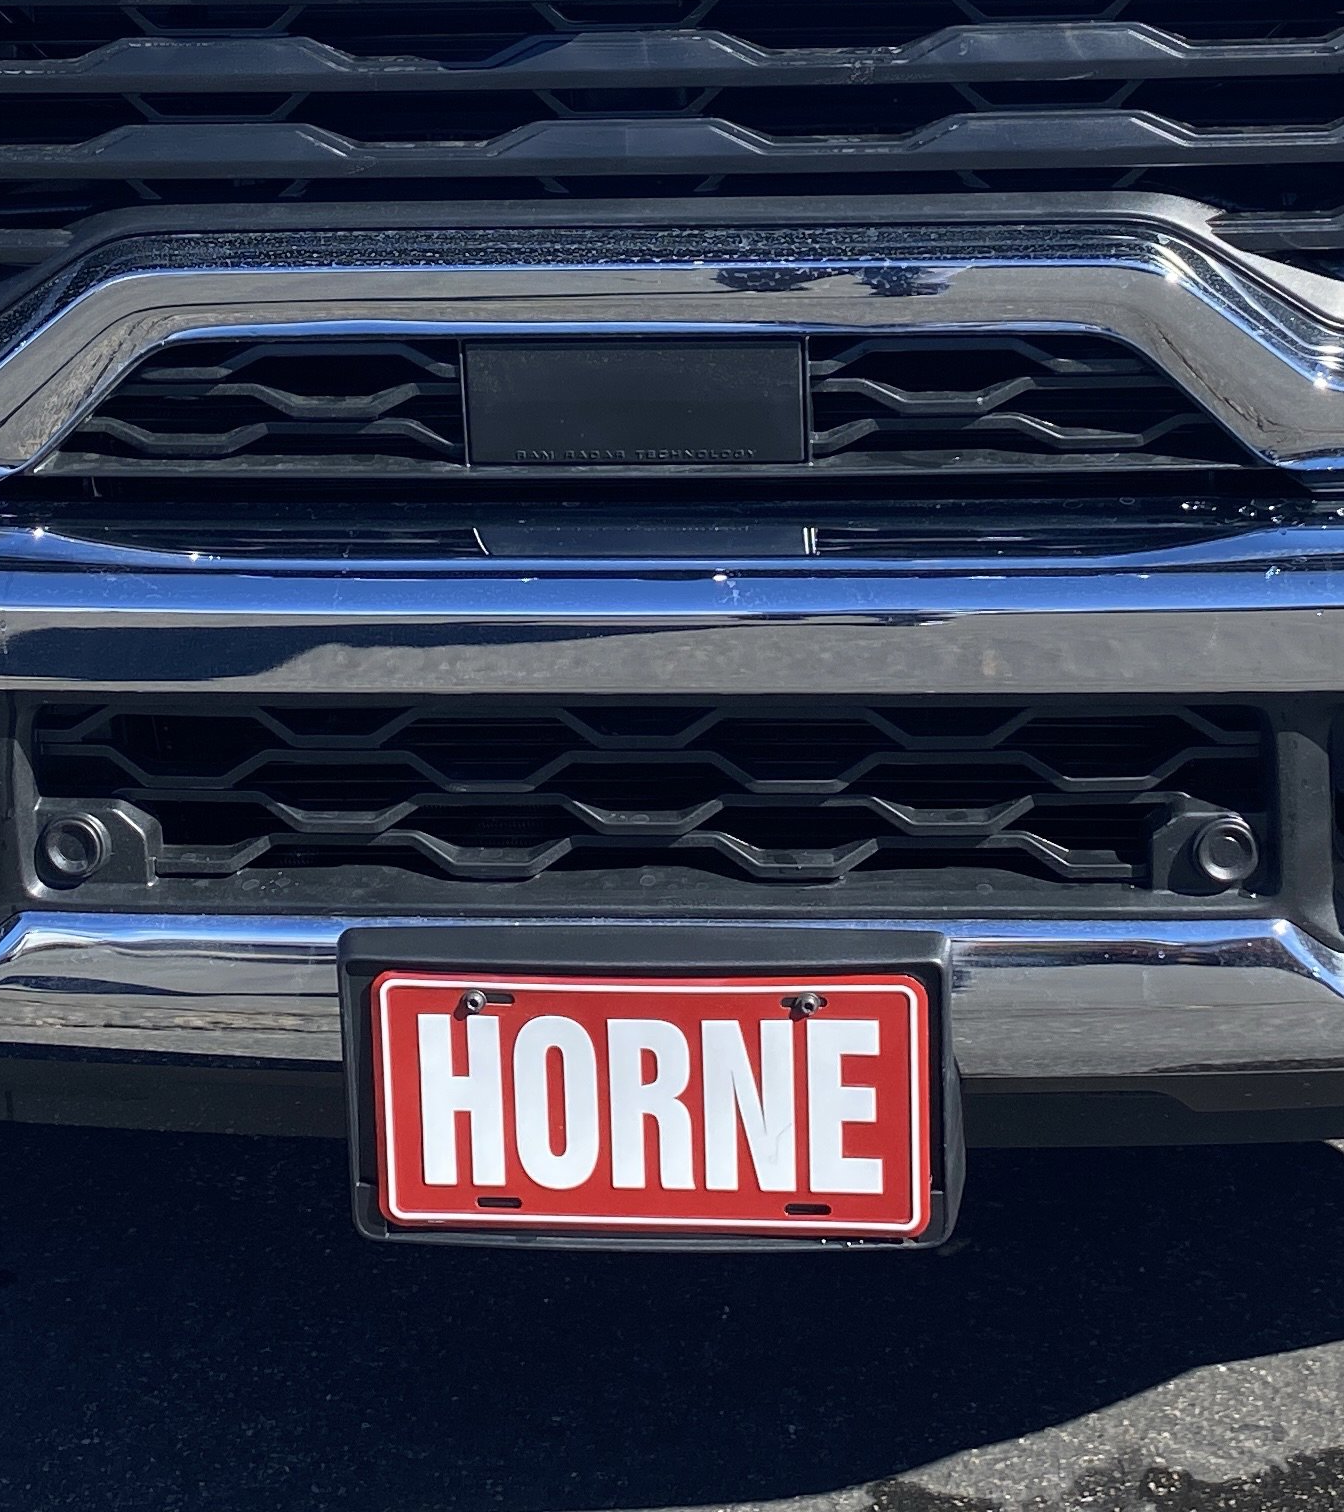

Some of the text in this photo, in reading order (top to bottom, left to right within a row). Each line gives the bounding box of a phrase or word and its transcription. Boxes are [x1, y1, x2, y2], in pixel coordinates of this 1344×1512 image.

[516, 449, 757, 461] RAM RADAR TECHNOLOGY
[417, 1013, 884, 1195] HORNE
